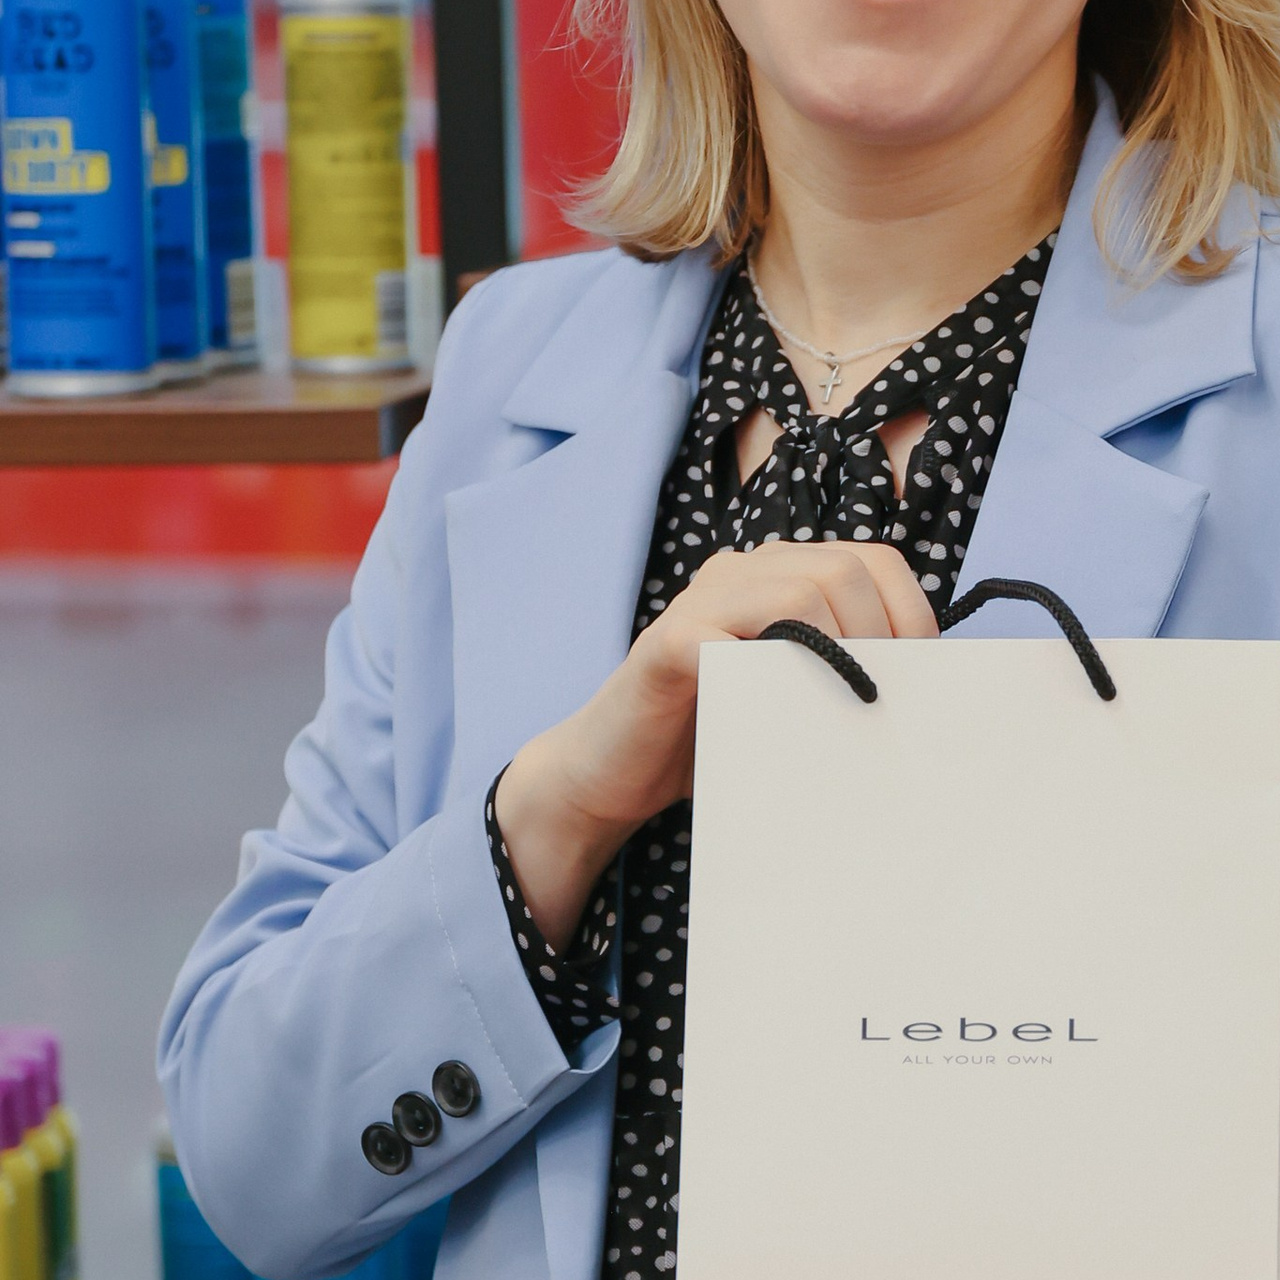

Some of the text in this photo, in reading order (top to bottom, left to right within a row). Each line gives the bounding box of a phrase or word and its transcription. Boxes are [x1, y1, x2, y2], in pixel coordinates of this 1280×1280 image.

[902, 1054, 1053, 1065] ALL YOUR OWN
